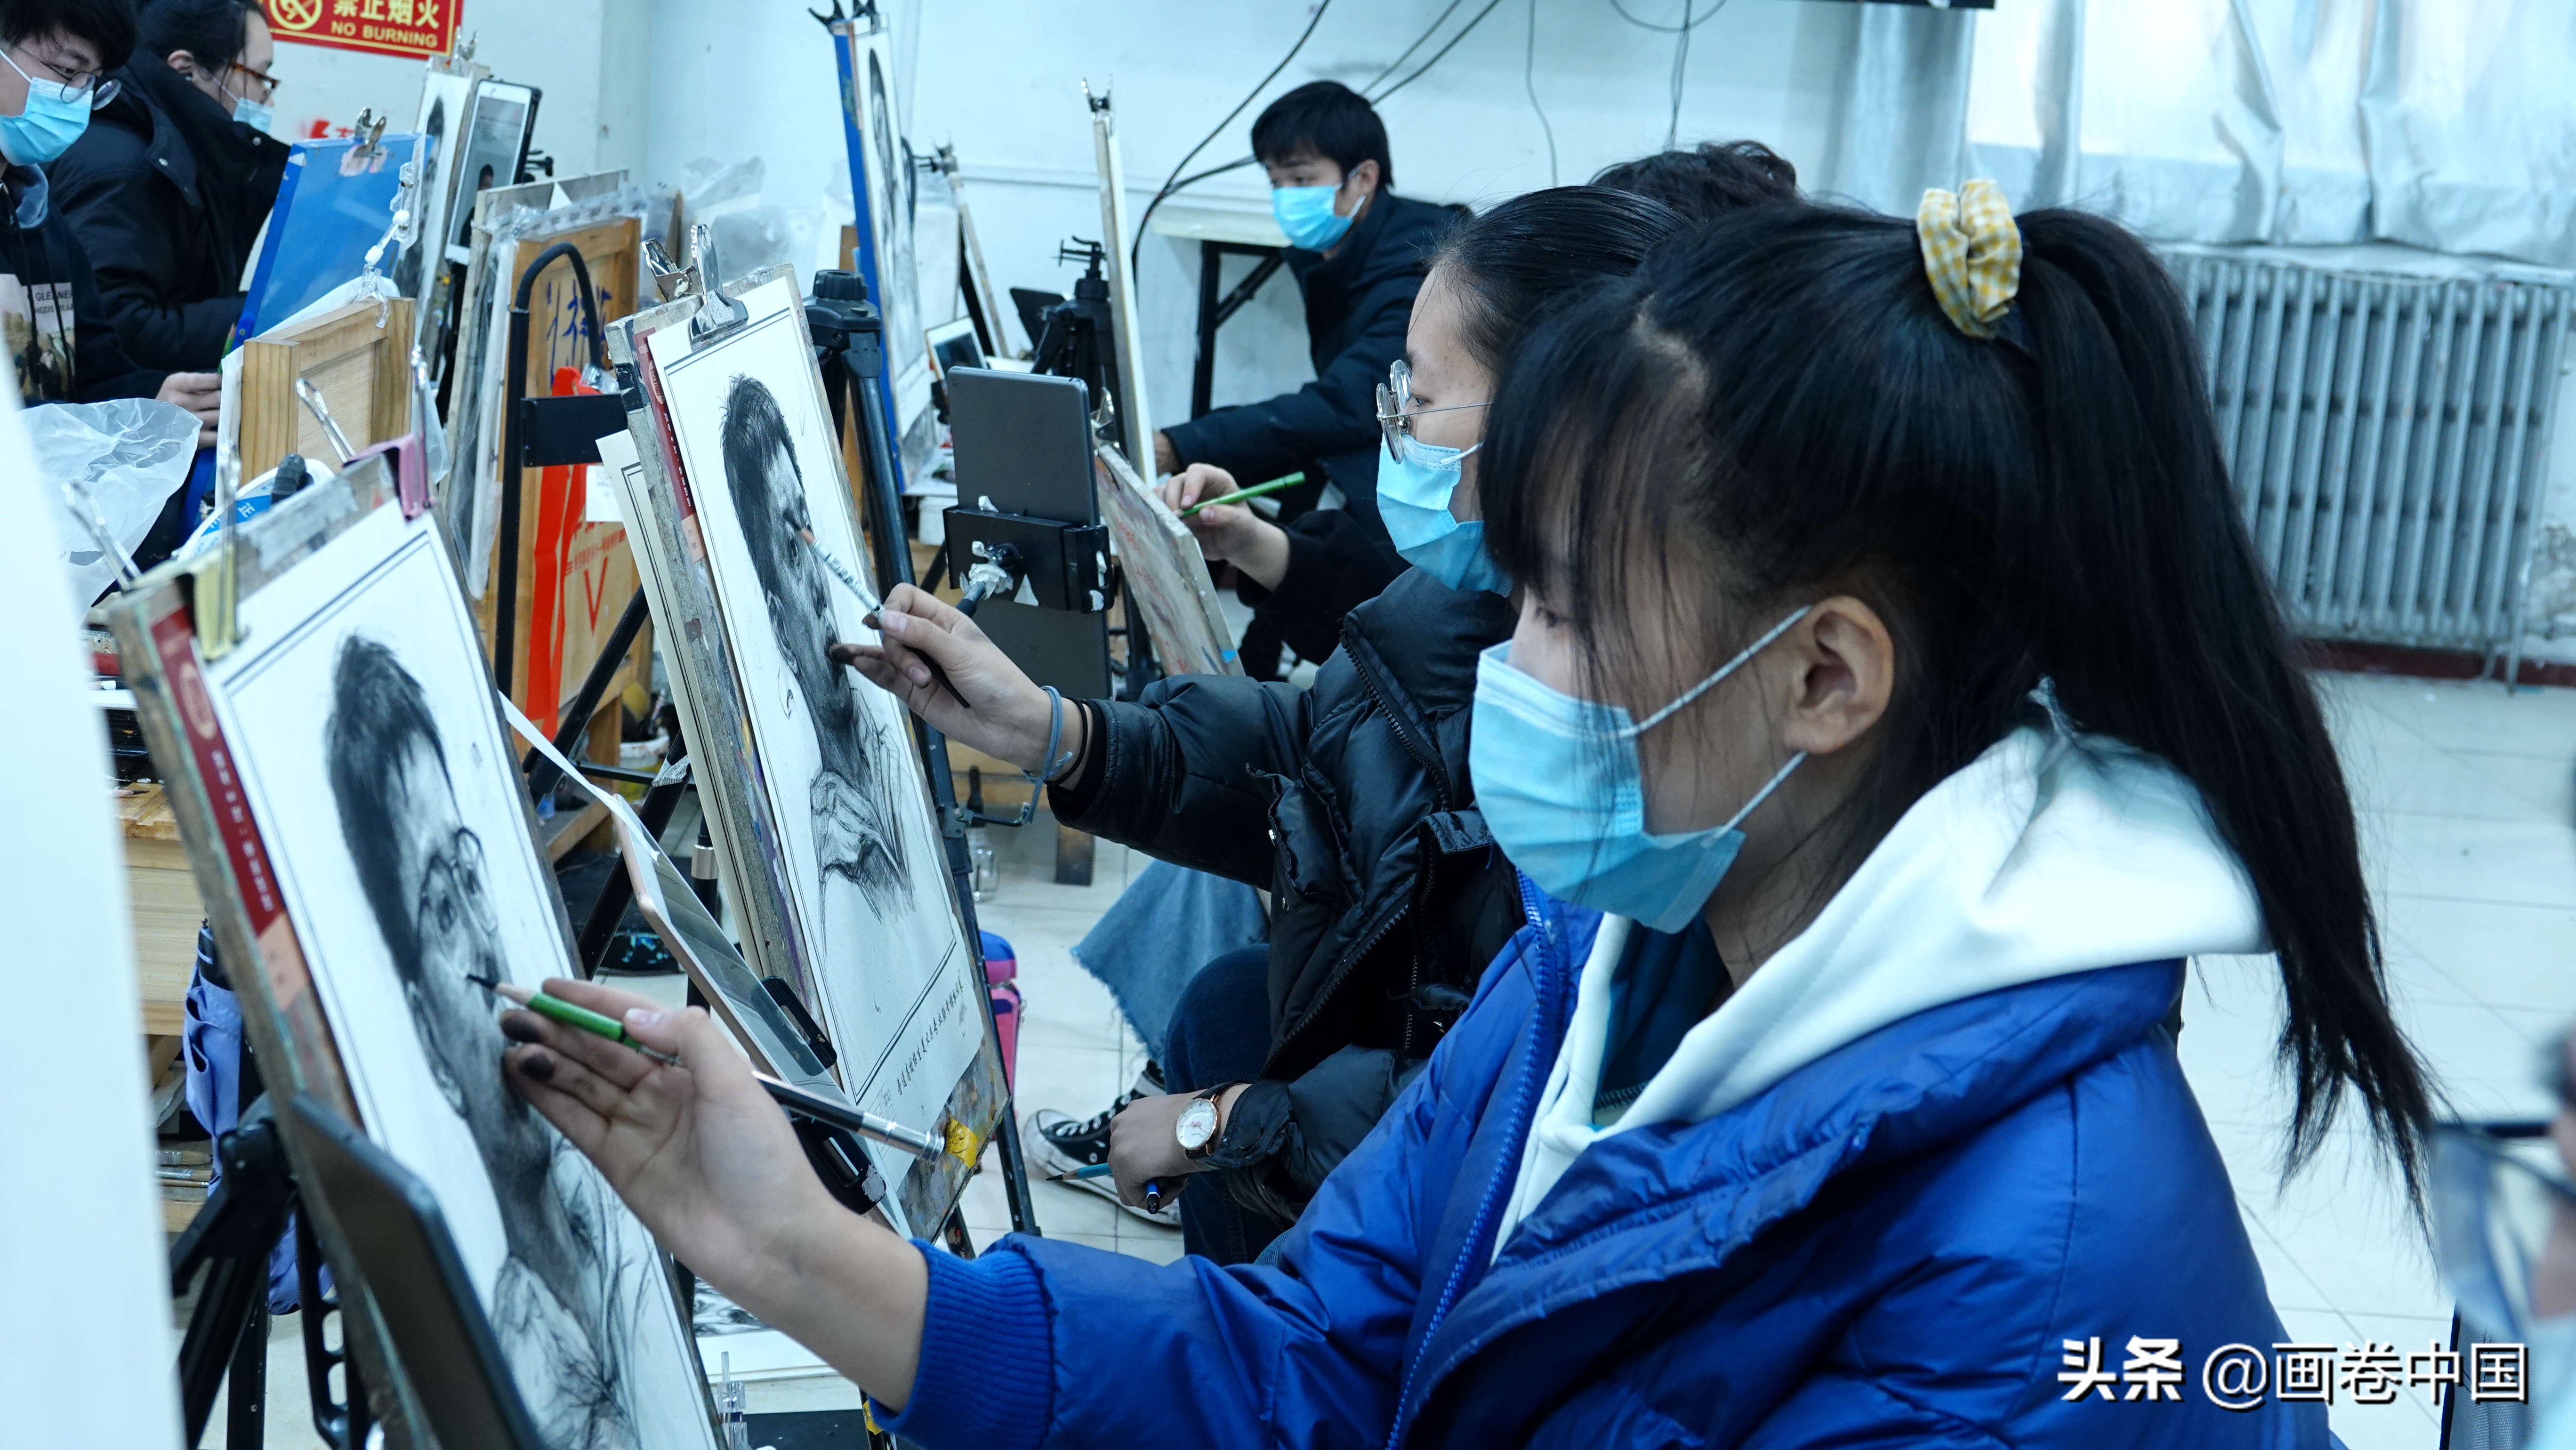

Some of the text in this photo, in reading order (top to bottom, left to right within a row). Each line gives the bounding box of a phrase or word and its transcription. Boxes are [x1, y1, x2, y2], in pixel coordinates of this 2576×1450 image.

[333, 0, 440, 29] 禁止烟火
[331, 20, 438, 48] NO BURNING
